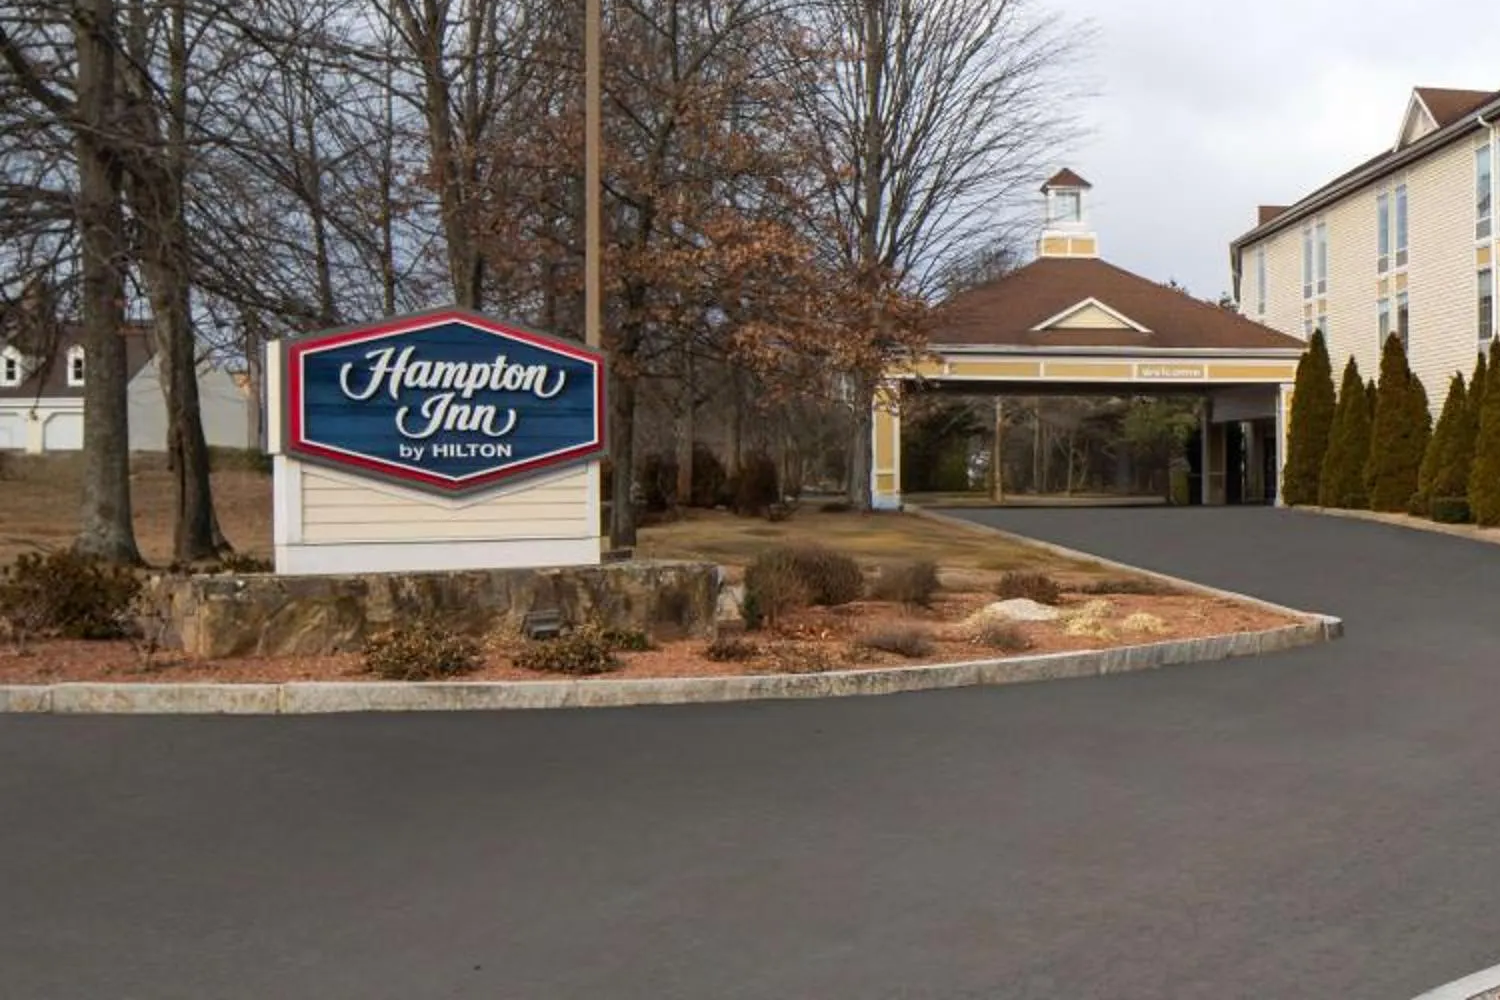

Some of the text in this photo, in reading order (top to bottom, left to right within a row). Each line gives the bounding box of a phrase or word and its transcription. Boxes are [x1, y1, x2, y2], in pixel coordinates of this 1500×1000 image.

[340, 346, 565, 400] Hampton
[395, 393, 516, 438] Inn
[399, 443, 512, 461] by HILTON
